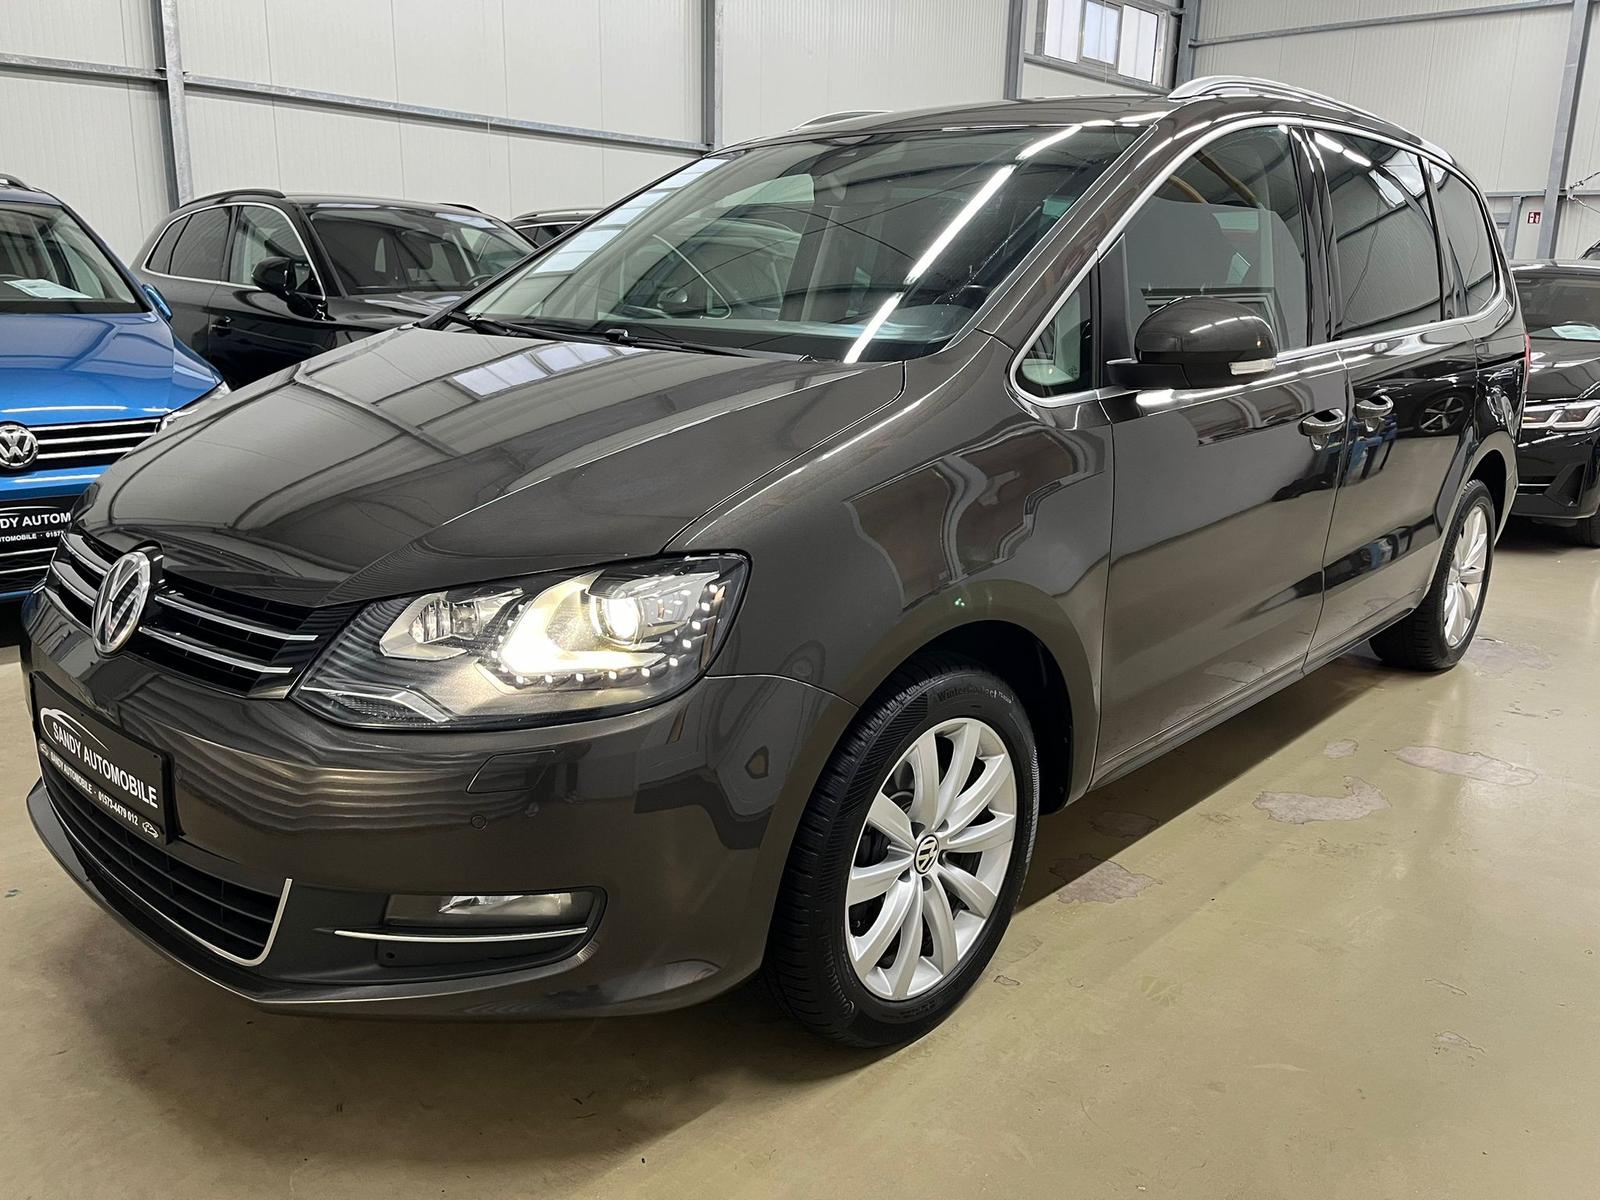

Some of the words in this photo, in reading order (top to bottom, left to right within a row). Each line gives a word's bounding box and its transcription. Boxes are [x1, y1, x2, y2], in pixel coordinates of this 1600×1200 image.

[50, 751, 64, 771] SANDY
[63, 764, 93, 795] AUTOMOBILE
[127, 811, 139, 826] 012
[52, 721, 82, 759] SANDY
[84, 745, 159, 809] AUTOMOBILE
